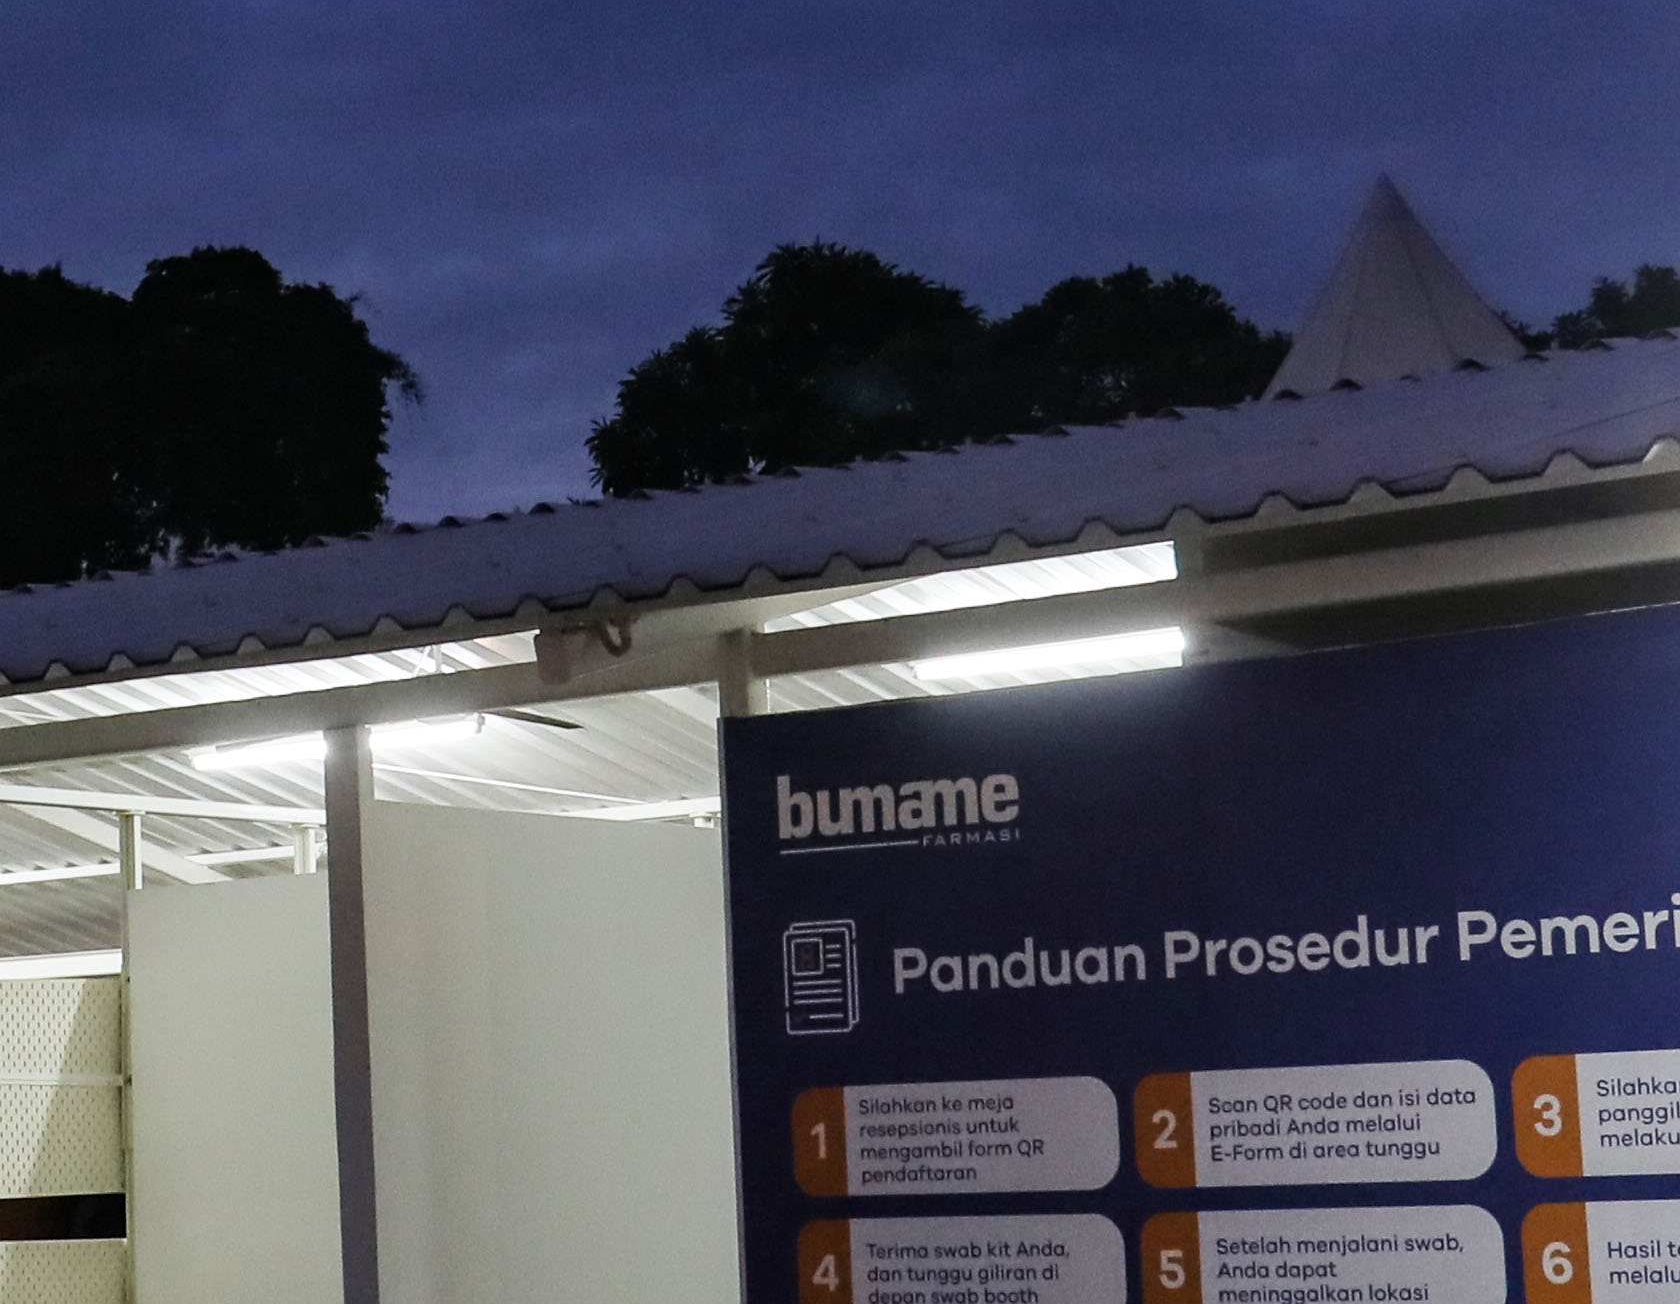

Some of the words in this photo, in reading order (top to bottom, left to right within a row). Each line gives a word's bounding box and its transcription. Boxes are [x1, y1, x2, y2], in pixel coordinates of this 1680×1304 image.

[777, 773, 1020, 840] bumame
[923, 829, 1021, 847] FARMASI
[892, 934, 1146, 996] Panduan
[1162, 915, 1441, 981] Prosedur
[859, 1097, 937, 1116] Silahkan
[942, 1095, 963, 1113] ke
[968, 1095, 1015, 1115] meja
[1208, 1097, 1258, 1115] Scan
[1264, 1095, 1293, 1114] QR
[1298, 1092, 1347, 1111] code
[1353, 1091, 1392, 1109] dan
[1398, 1090, 1420, 1107] isi
[1426, 1088, 1477, 1106] data
[1210, 1119, 1281, 1141] pribadi
[1287, 1117, 1340, 1135] Anda
[1345, 1114, 1422, 1133] melalui
[1533, 1094, 1563, 1137] 3
[810, 1121, 828, 1160] 1
[860, 1119, 962, 1140] resepsionis
[966, 1117, 1020, 1135] untuk
[1152, 1110, 1178, 1150] 2
[861, 1142, 963, 1165] mengambil
[968, 1140, 1013, 1158] form
[1017, 1139, 1045, 1158] QR
[1211, 1144, 1284, 1162] E-Form
[1289, 1142, 1308, 1160] di
[1313, 1144, 1360, 1158] area
[1366, 1140, 1441, 1160] tunggu
[861, 1165, 978, 1186] pendaftaran
[866, 1242, 929, 1260] Terima
[934, 1241, 983, 1259] swab
[987, 1241, 1011, 1258] kit
[1017, 1240, 1070, 1260] Anda,
[1216, 1236, 1291, 1256] Setelah
[1296, 1234, 1399, 1257] menjalani
[1405, 1233, 1465, 1253] swab,
[1607, 1239, 1662, 1260] Hasil
[812, 1254, 840, 1292] 4
[867, 1266, 902, 1283] dan
[908, 1265, 973, 1285] tunggu
[979, 1264, 1037, 1285] giliran
[1042, 1264, 1060, 1281] di
[1158, 1248, 1186, 1290] 5
[1218, 1261, 1270, 1279] Anda
[1275, 1260, 1338, 1282] dapat
[1542, 1241, 1574, 1285] 6
[931, 1288, 980, 1304] swab
[984, 1288, 1039, 1304] booth
[1368, 1283, 1429, 1302] lokasi
